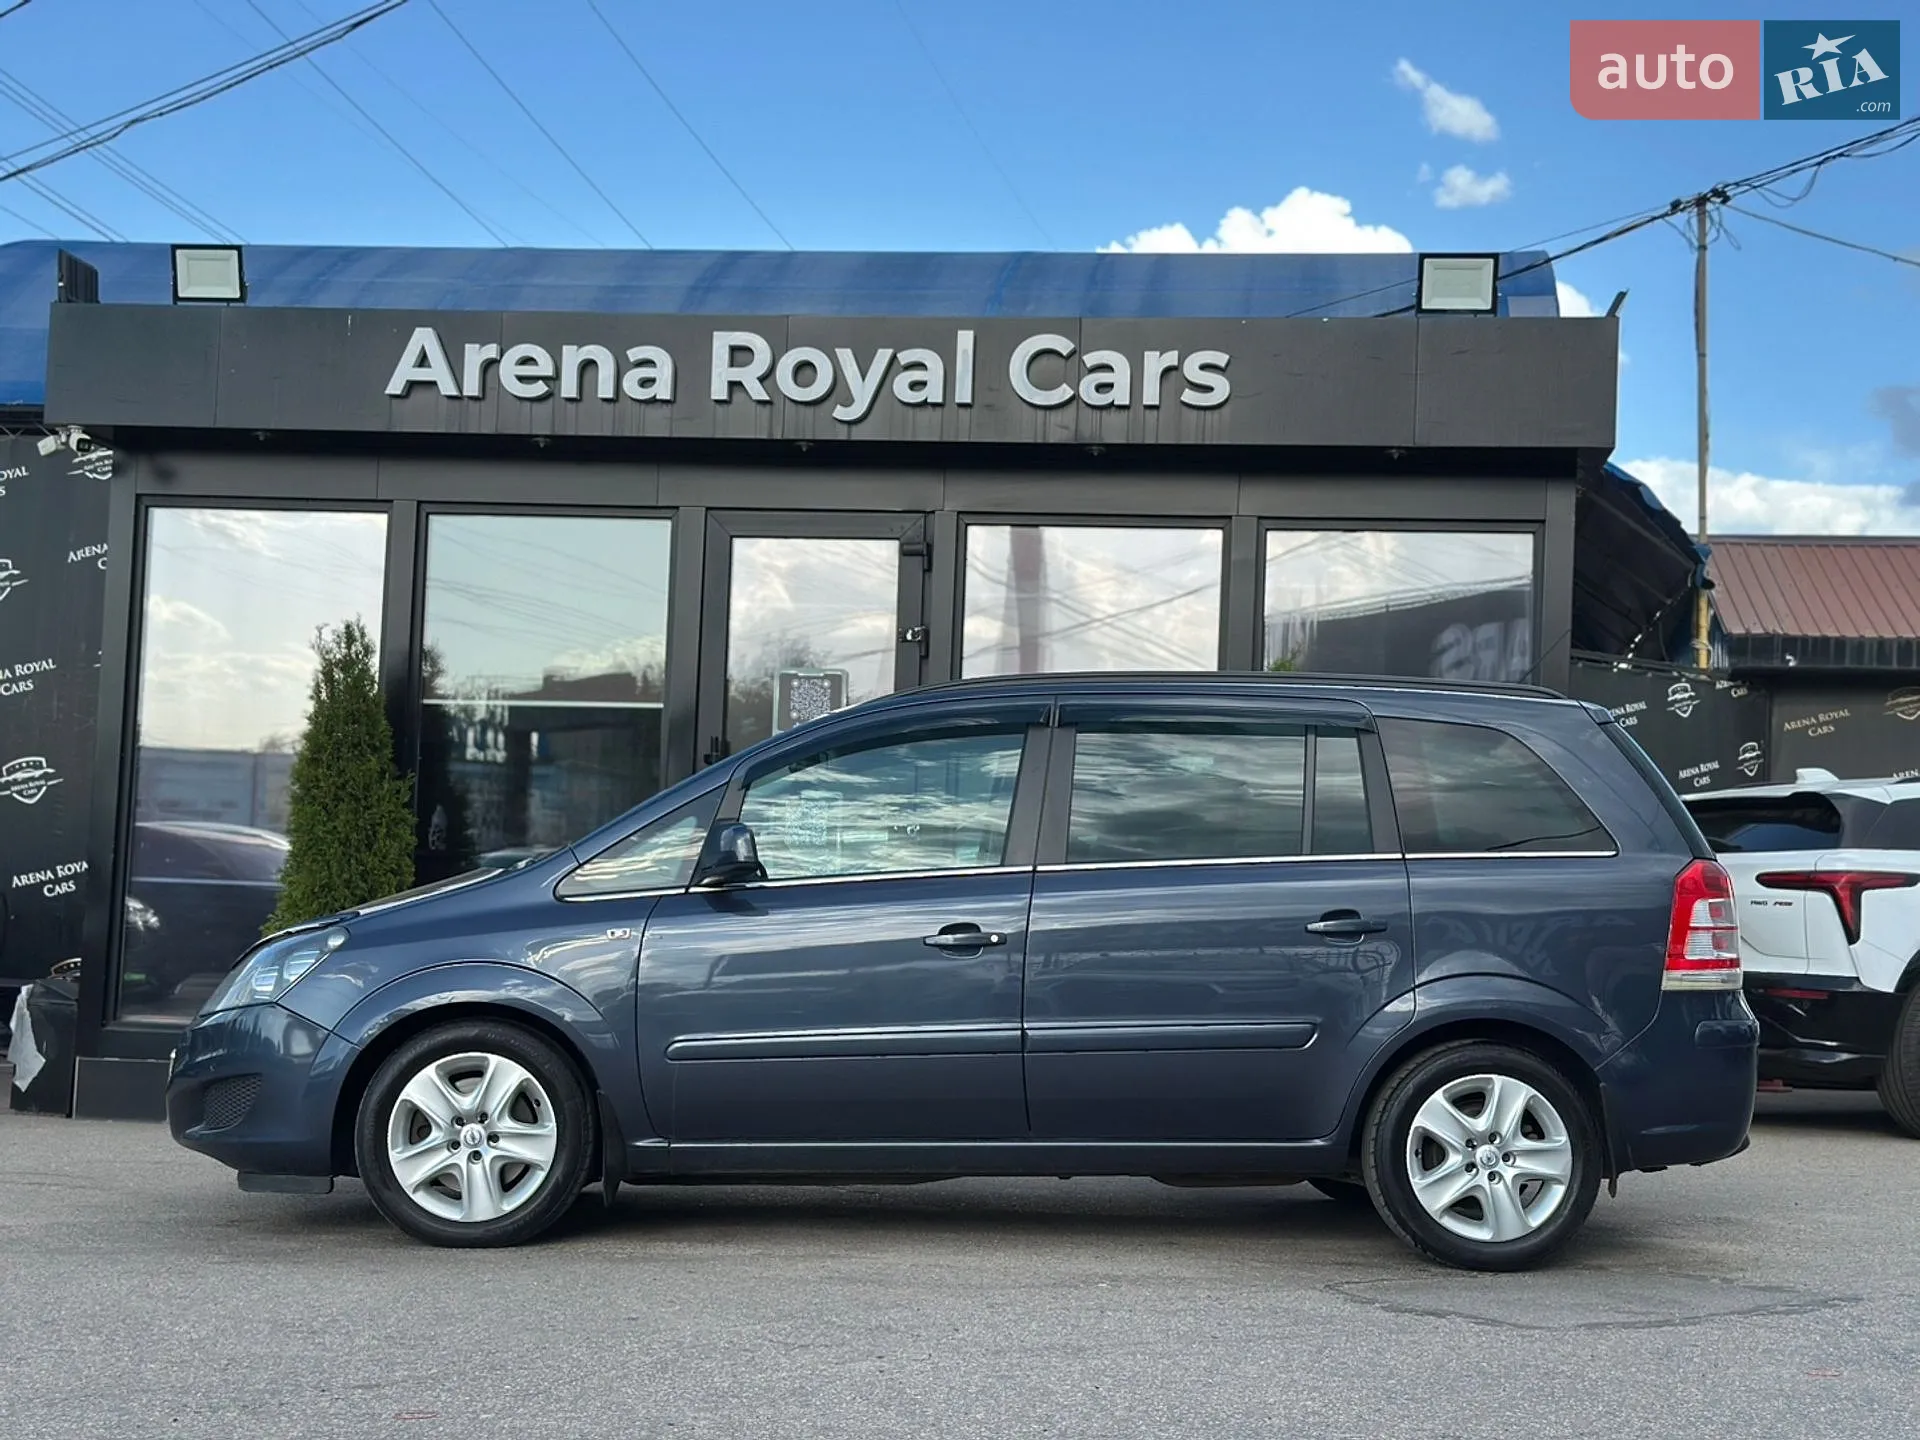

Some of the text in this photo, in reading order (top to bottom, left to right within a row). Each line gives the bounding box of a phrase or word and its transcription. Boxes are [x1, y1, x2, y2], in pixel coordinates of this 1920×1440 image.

[385, 326, 1231, 423] Arena Royal Cars
[0, 466, 30, 481] OYAL
[67, 543, 108, 563] ARENA
[14, 658, 57, 676] ROYAL
[1, 679, 34, 695] CARS
[1783, 708, 1850, 732] ARENA ROYAL
[1808, 725, 1835, 736] CARS
[12, 860, 89, 888] ARENA ROYA
[43, 880, 76, 897] CARS
